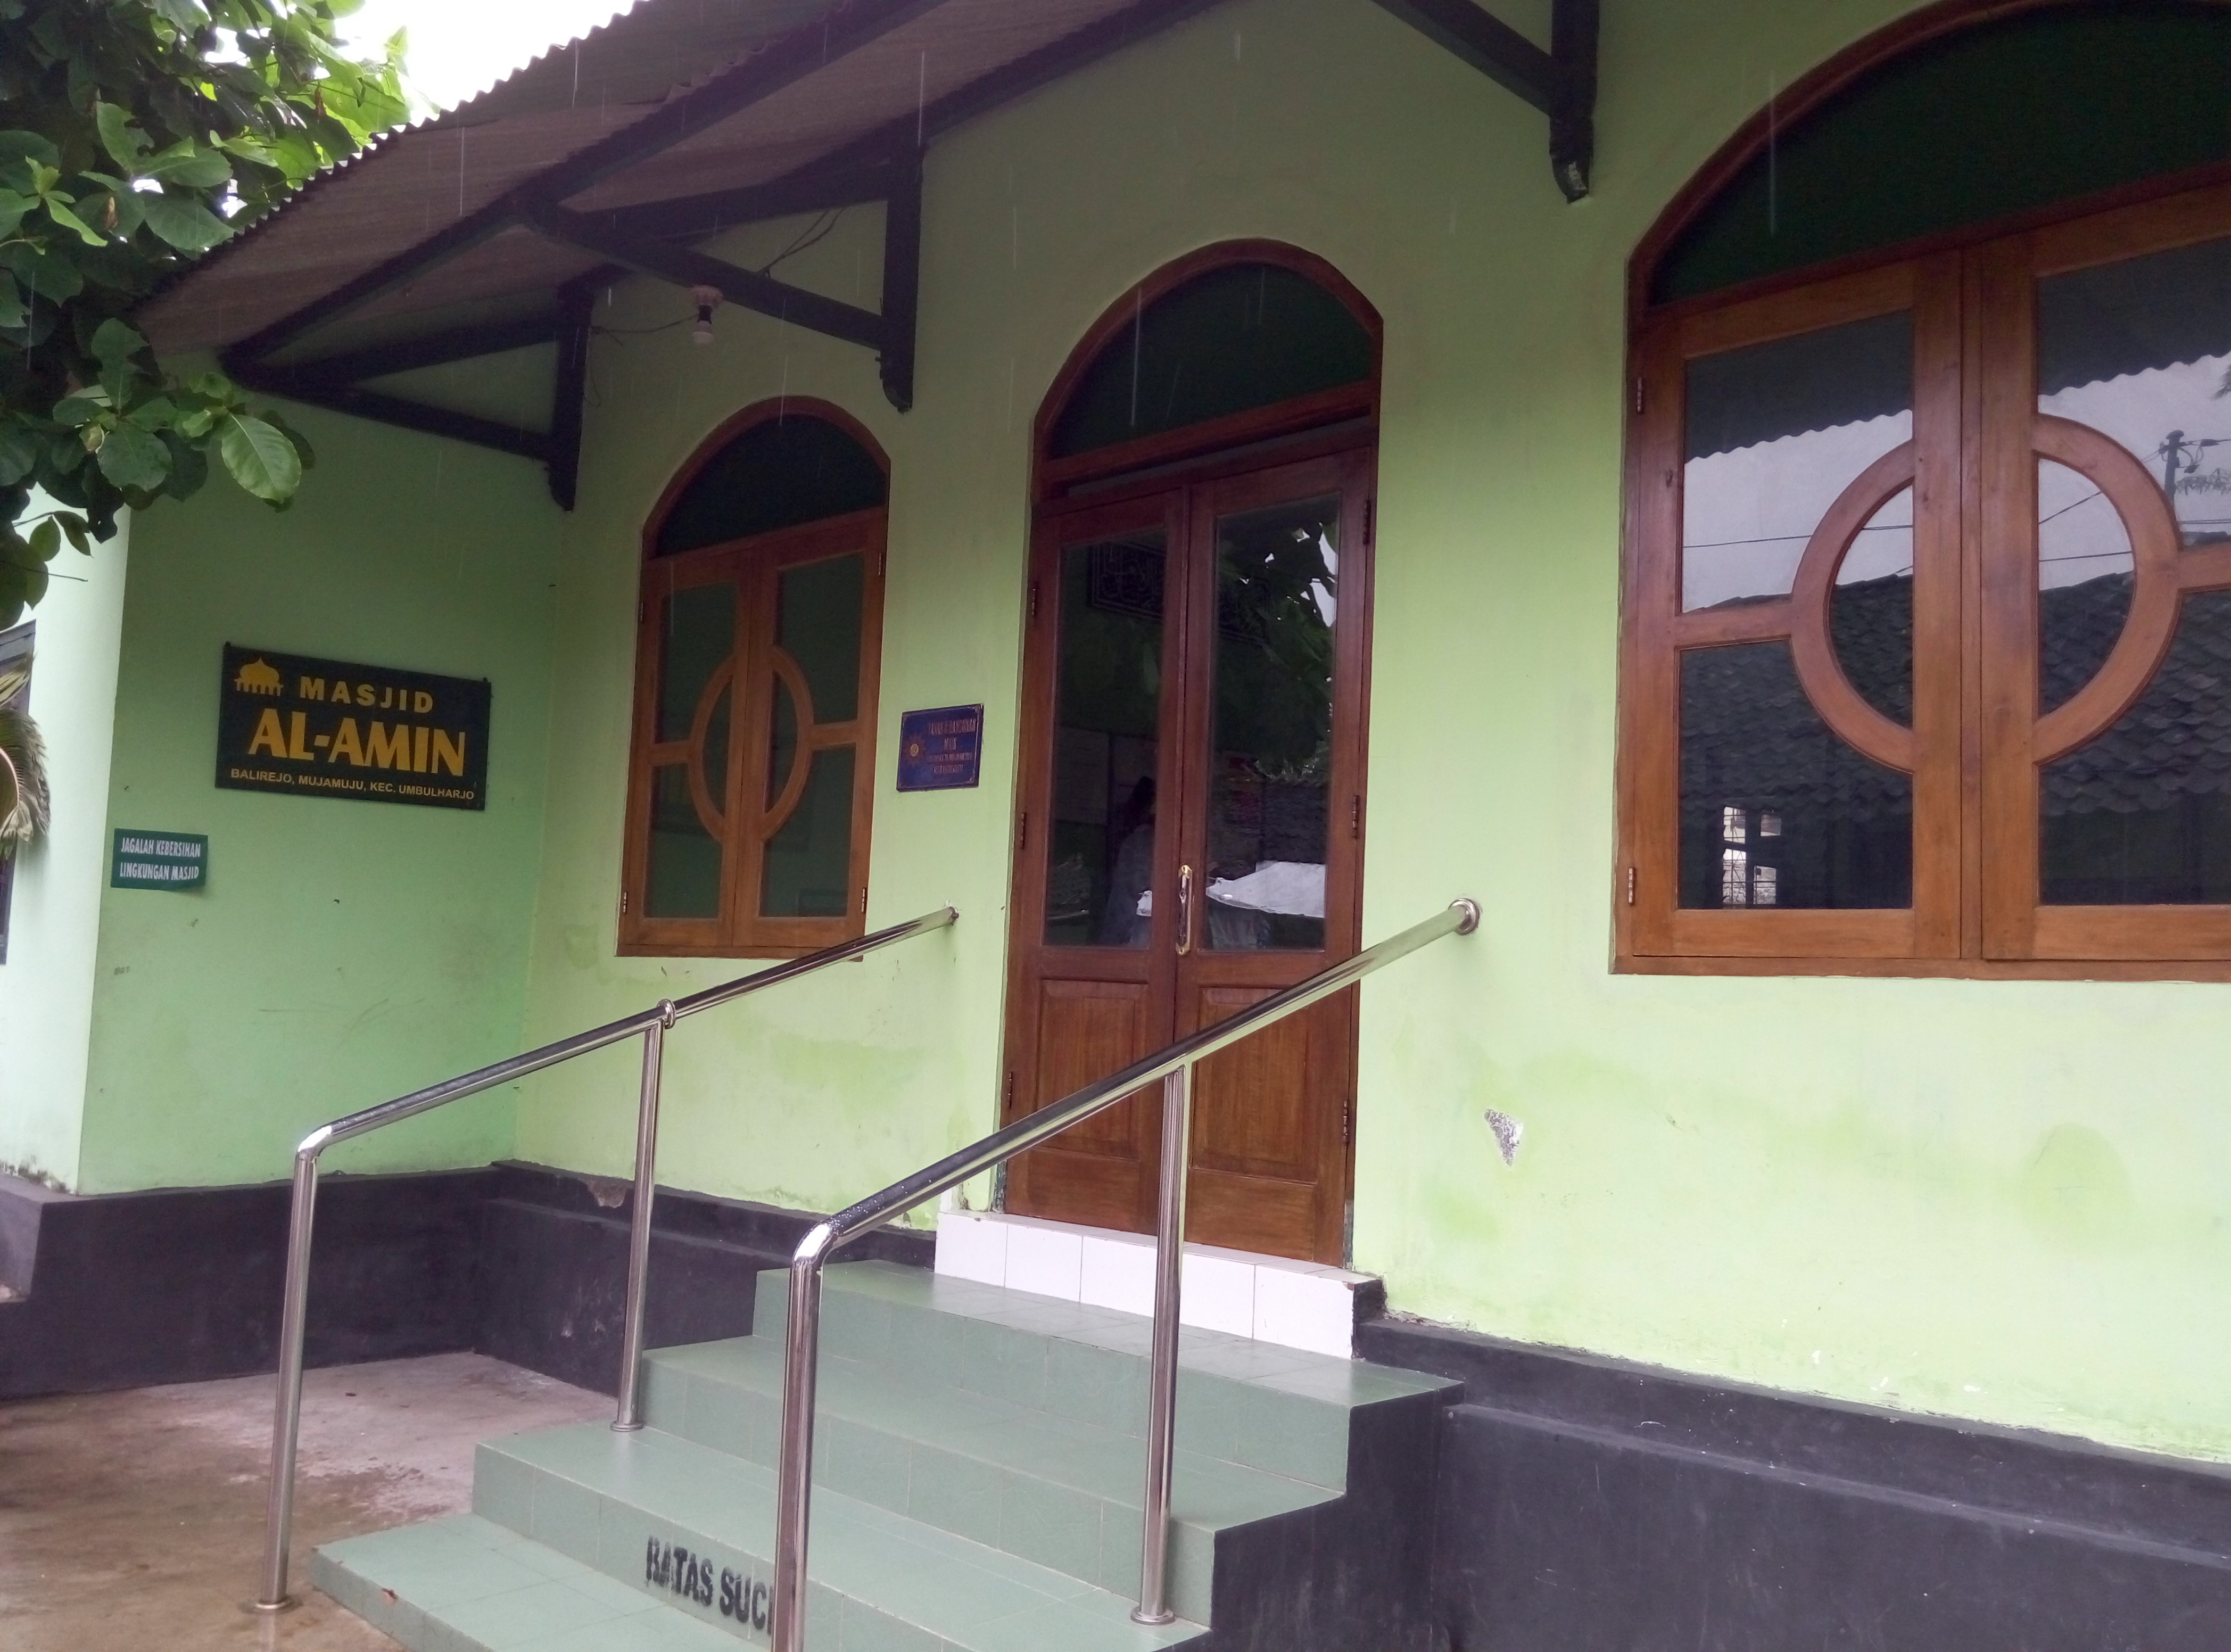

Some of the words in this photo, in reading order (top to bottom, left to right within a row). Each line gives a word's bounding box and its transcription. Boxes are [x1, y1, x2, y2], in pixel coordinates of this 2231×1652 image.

[300, 676, 434, 714] MASJID
[248, 708, 465, 777] AL-AMIN
[230, 768, 295, 785] BALIREJO,
[299, 775, 367, 792] MUJAMUJU,
[370, 782, 396, 794] KEC.
[399, 784, 475, 800] UMBULHARJO
[121, 837, 154, 854] JAGALAH
[155, 839, 201, 857] KEBERSIHAN
[119, 862, 169, 880] LINGKUNGAN
[171, 865, 199, 881] MASJID
